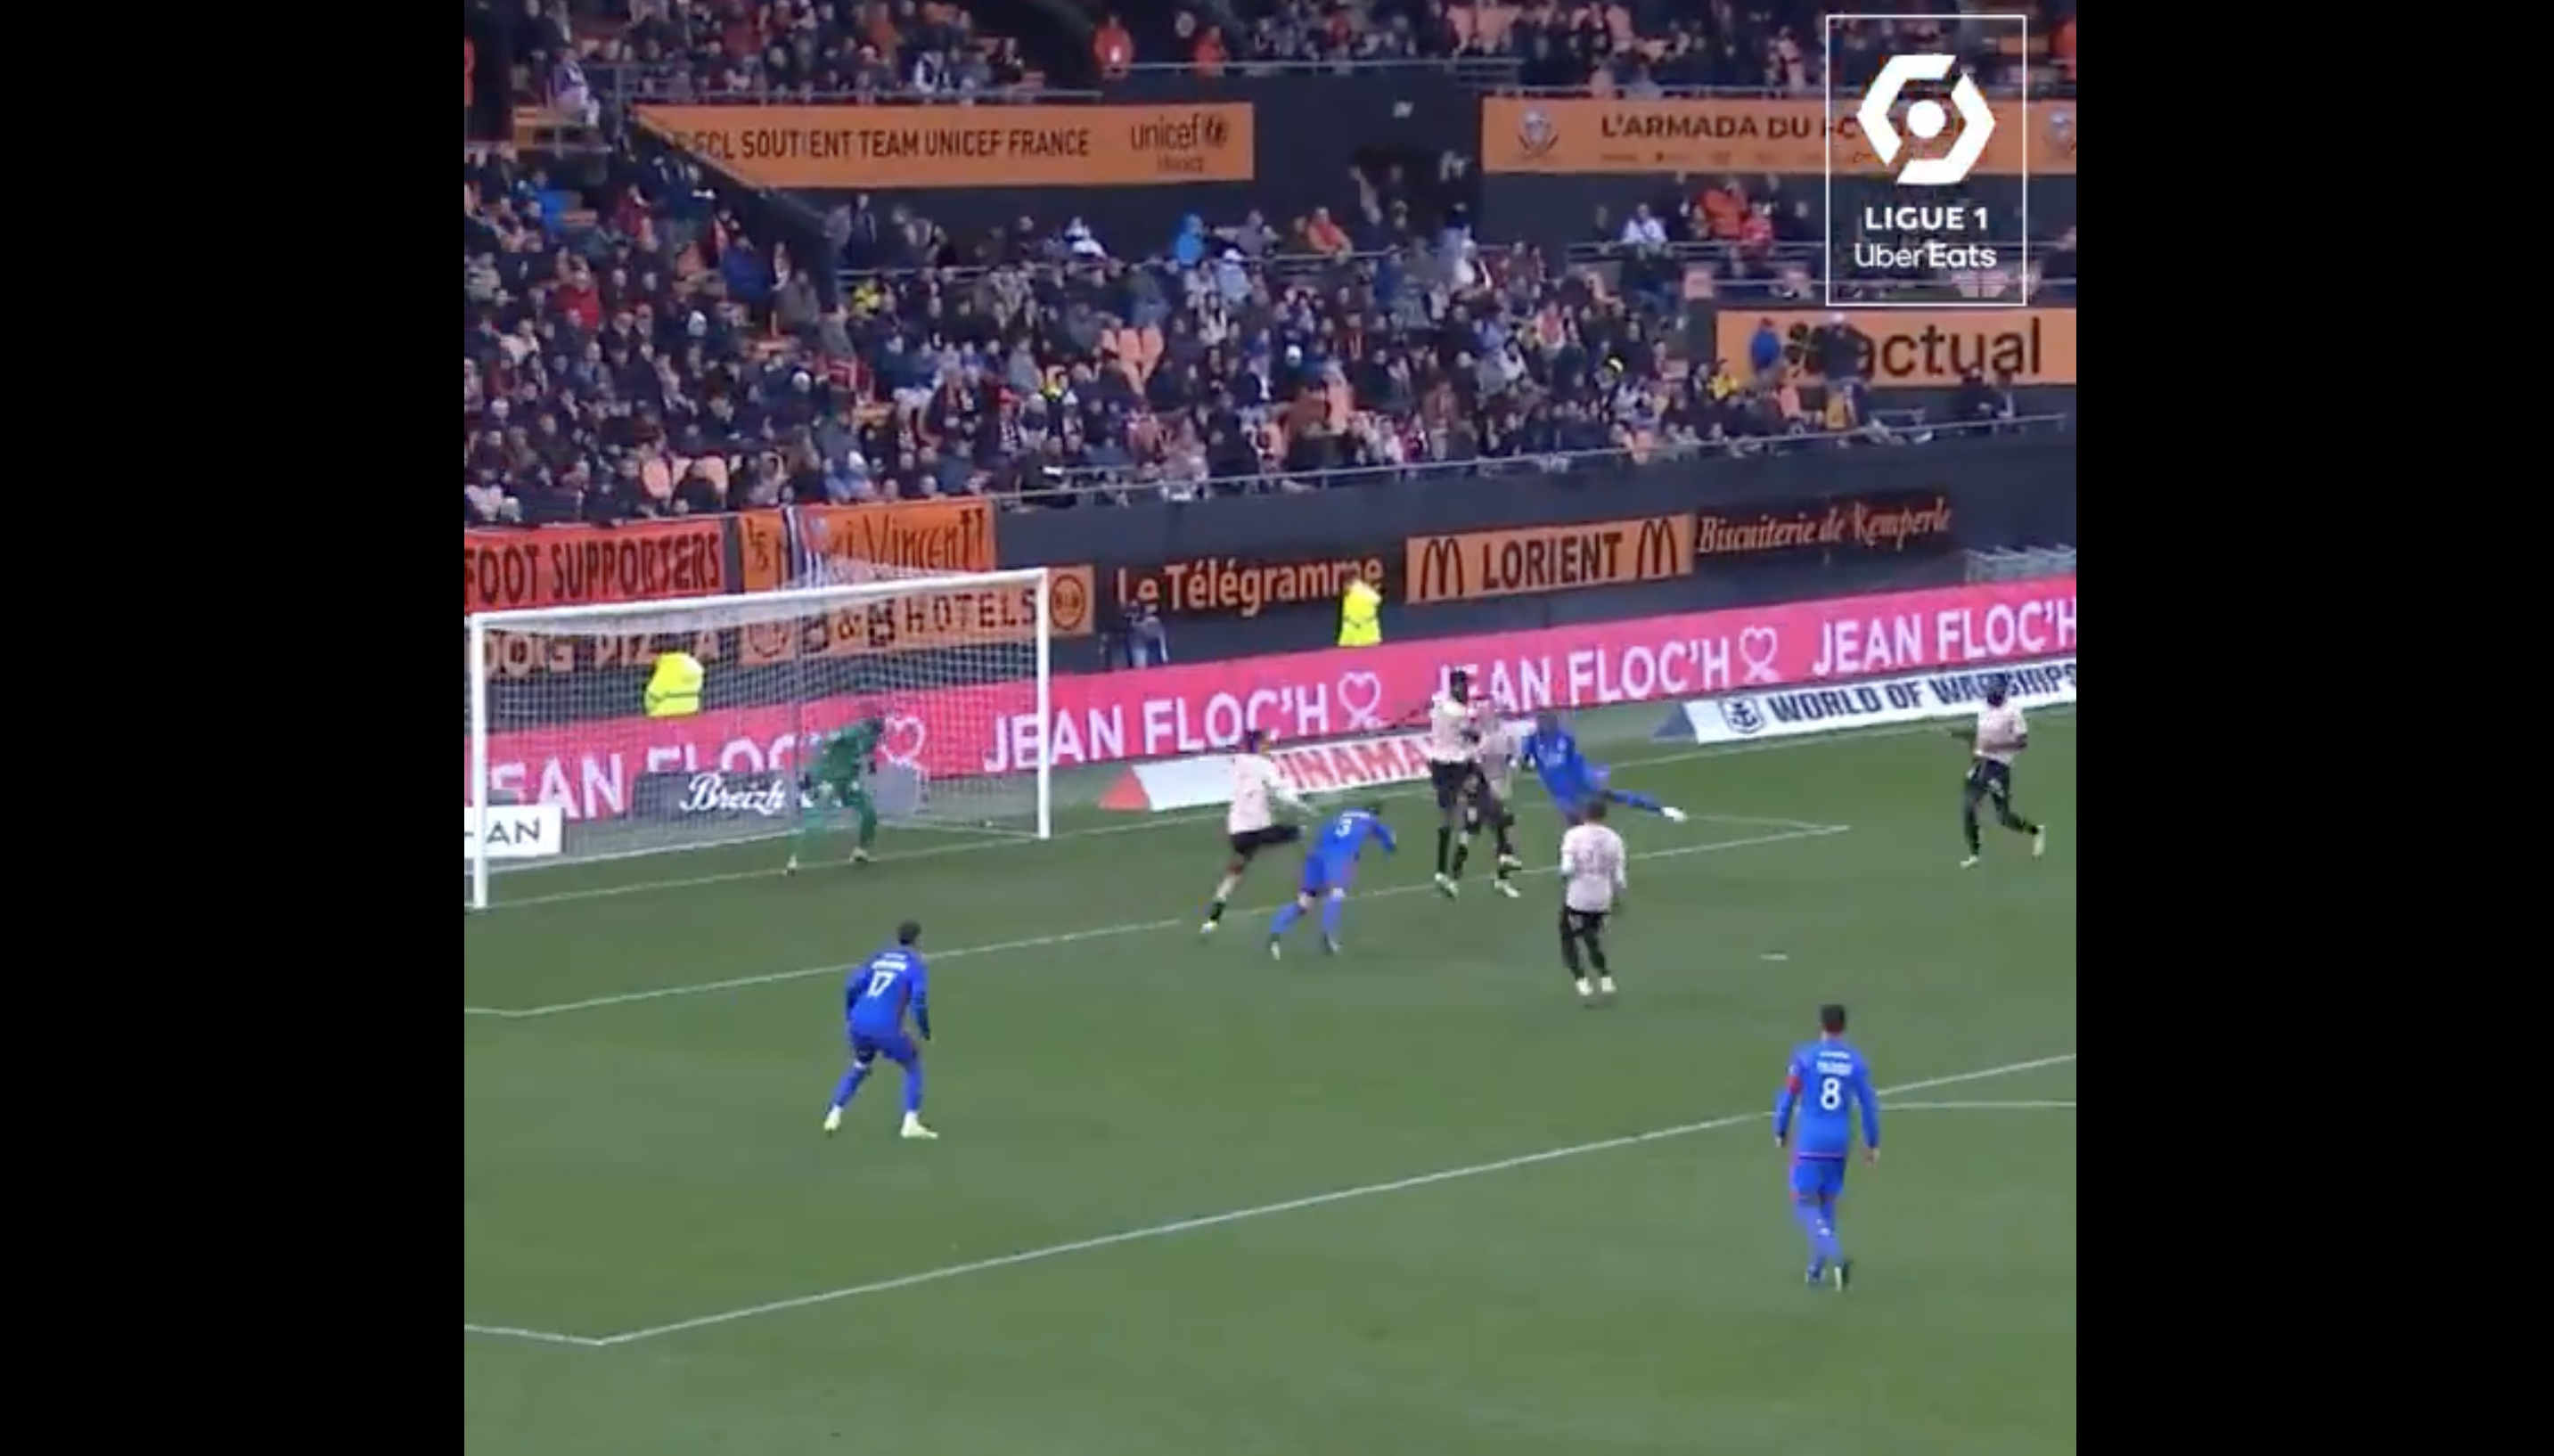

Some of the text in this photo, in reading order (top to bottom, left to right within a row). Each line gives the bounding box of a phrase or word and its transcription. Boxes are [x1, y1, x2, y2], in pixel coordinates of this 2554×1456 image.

[861, 129, 919, 158] TEAM
[924, 128, 1002, 158] UNICEF
[1009, 128, 1091, 158] FRANCE
[1130, 112, 1201, 151] unicef
[1602, 115, 1758, 139] L'ARMADA
[1768, 115, 1810, 140] DU
[1697, 511, 1818, 553] Biscuiterie
[1819, 506, 1846, 543] de
[464, 543, 539, 612] FOOT
[550, 532, 720, 599] SUPPORTERS
[1482, 531, 1624, 592] LORIENT
[905, 588, 1036, 634] HOTELS
[1117, 557, 1384, 618] Le Télégramme
[1812, 595, 2076, 676] JEAN FLOC'H
[1568, 636, 1730, 707] FLOC'H
[1765, 684, 1884, 724] WORLD
[1887, 680, 1925, 712] OF
[983, 683, 1329, 773] JEAN FLOC'H
[488, 753, 626, 819] EAN
[679, 772, 787, 816] Breizh
[1820, 1076, 1842, 1111] 8
